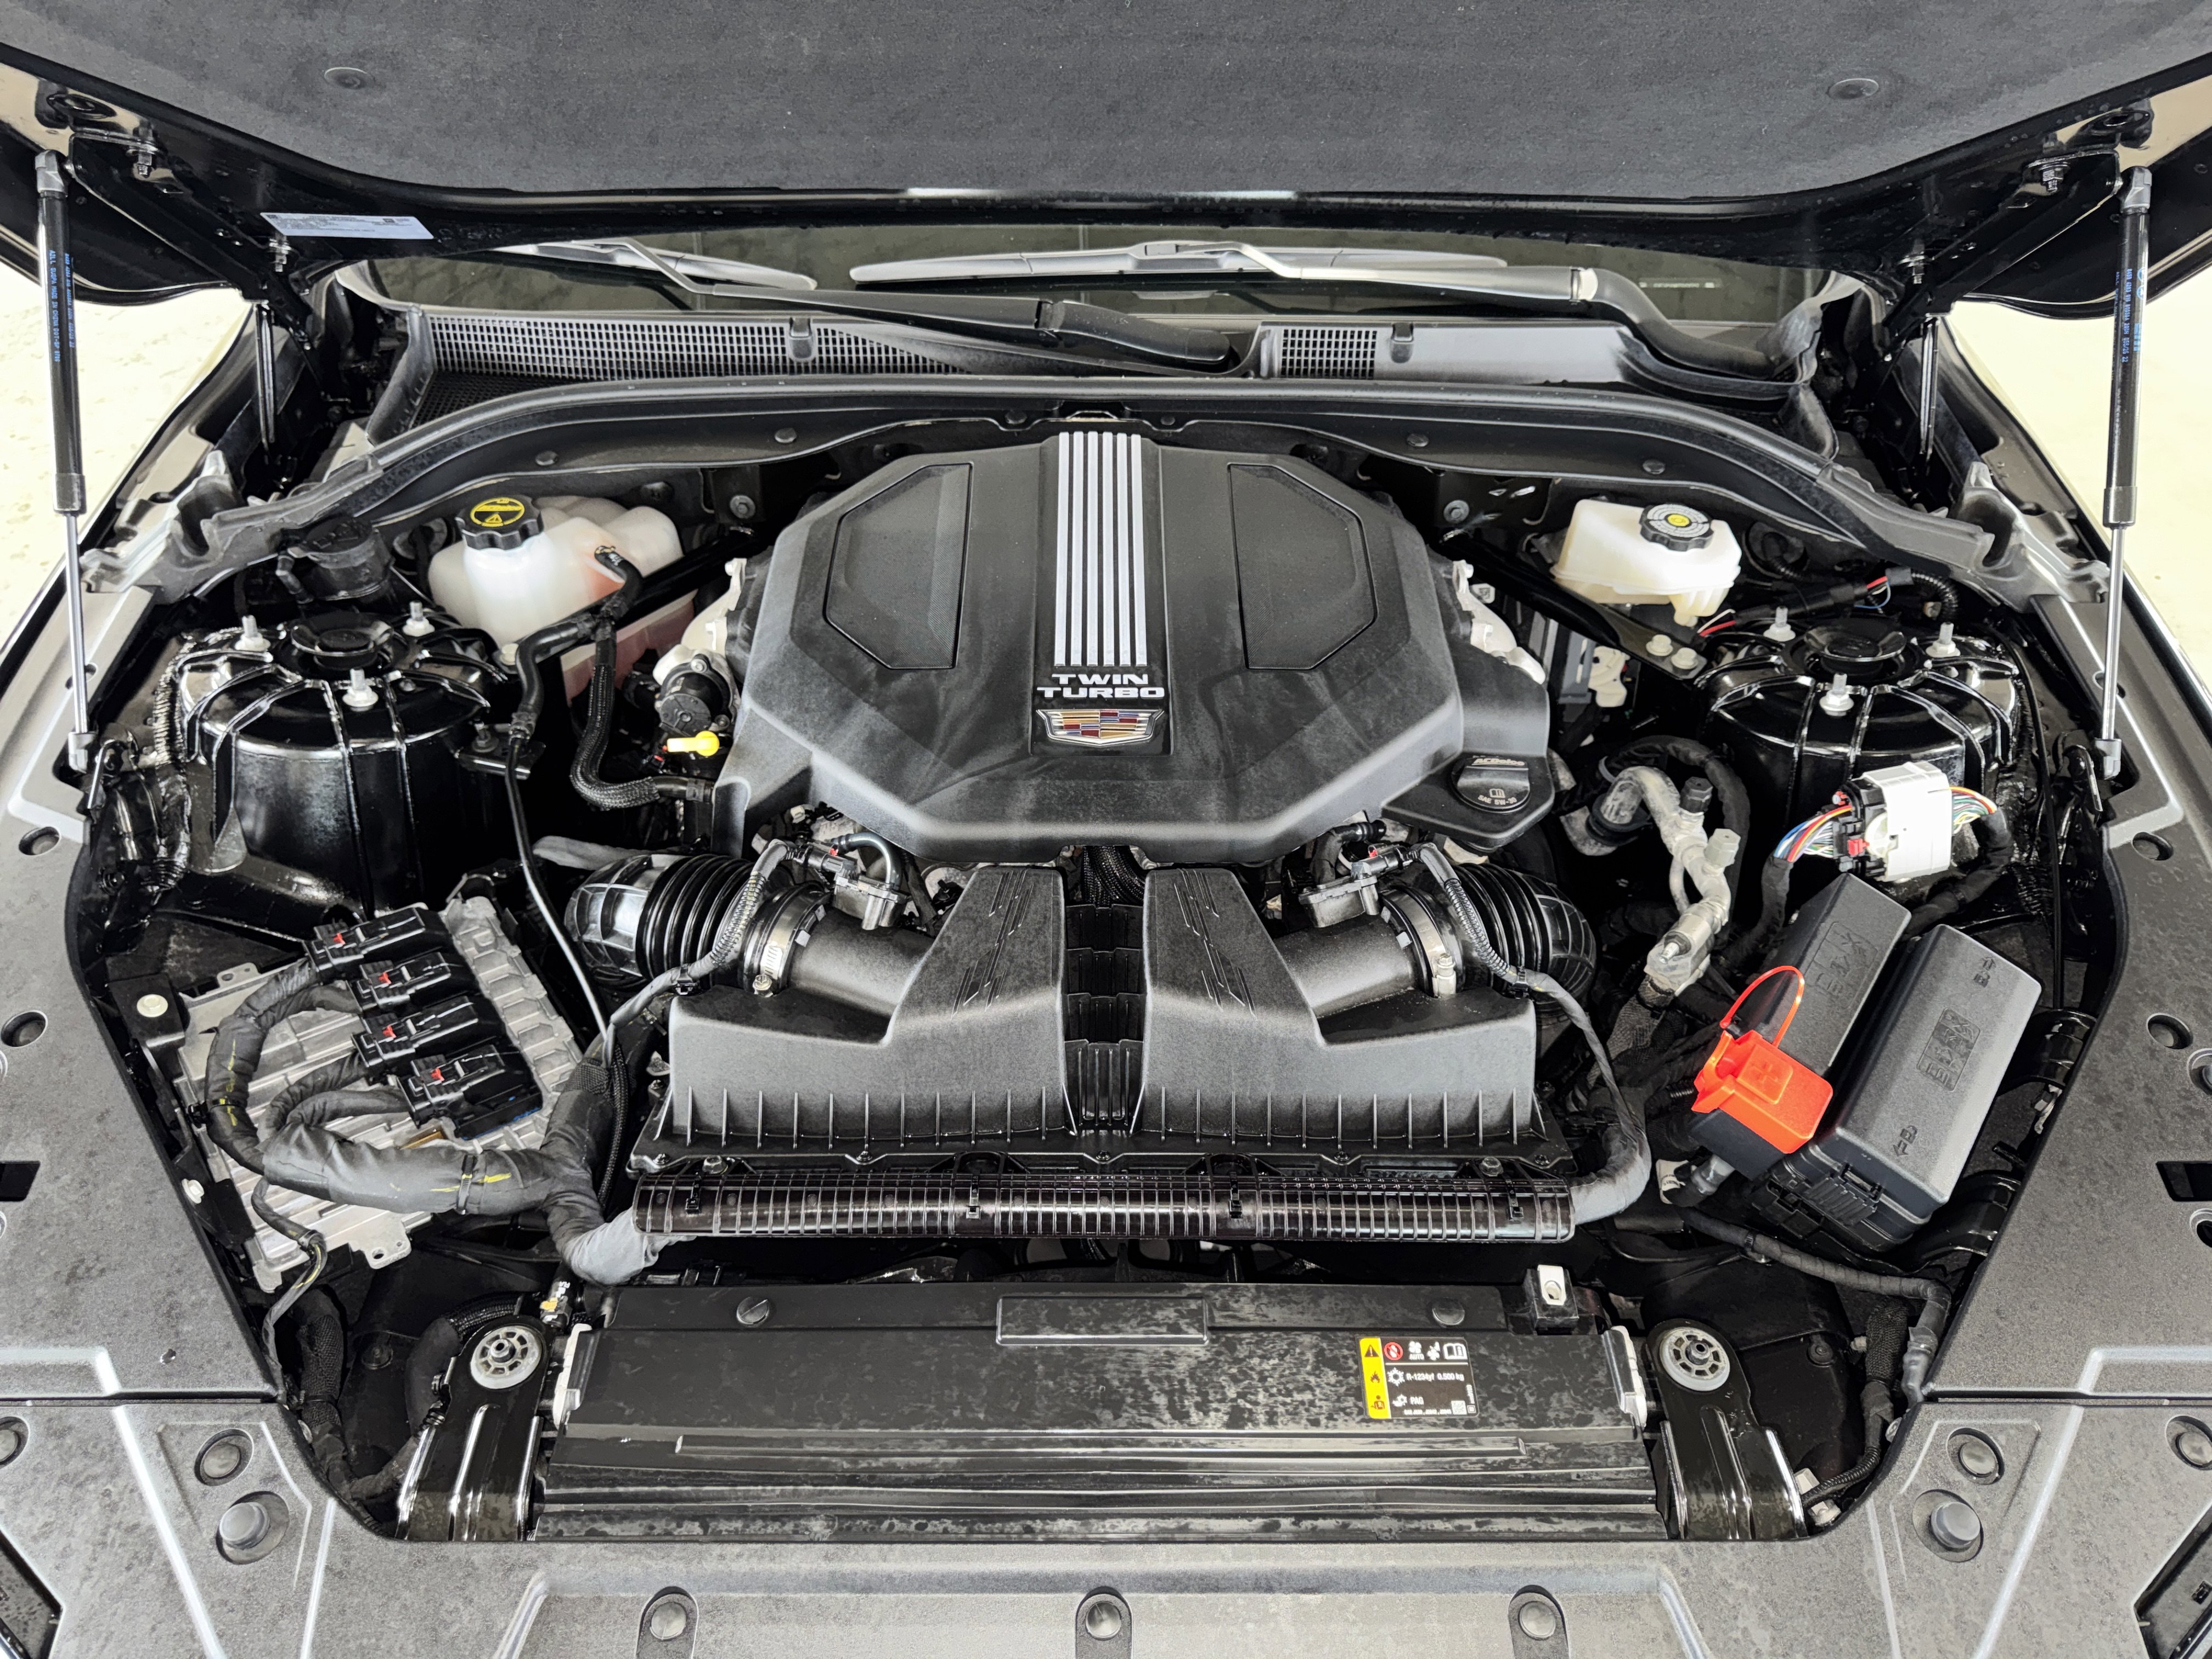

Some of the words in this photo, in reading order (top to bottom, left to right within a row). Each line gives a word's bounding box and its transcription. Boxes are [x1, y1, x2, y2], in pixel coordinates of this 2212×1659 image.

[1052, 674, 1148, 685] TWIN
[1037, 687, 1165, 699] TURBO
[1471, 758, 1525, 766] ACDelco
[1477, 794, 1492, 804] SAE
[1494, 797, 1517, 805] 5W-30
[1406, 1373, 1435, 1382] R-1234yf
[1455, 1373, 1465, 1381] kg
